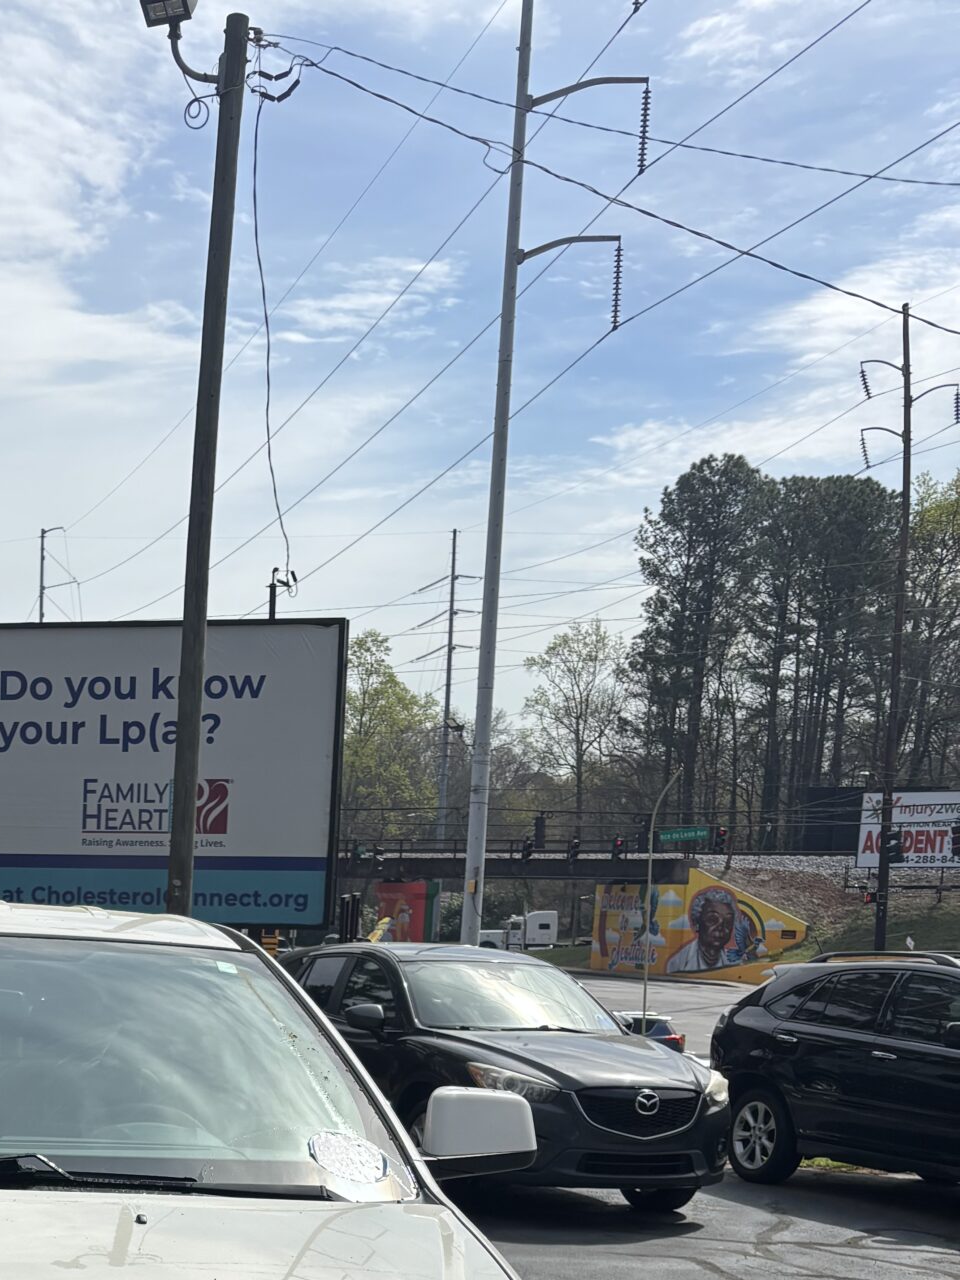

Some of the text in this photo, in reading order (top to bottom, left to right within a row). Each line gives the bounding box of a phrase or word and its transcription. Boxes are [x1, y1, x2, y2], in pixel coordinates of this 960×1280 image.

[0, 667, 267, 709] Do you kow
[99, 712, 222, 753] Lp(a?
[82, 778, 169, 803] FAMILY
[81, 803, 168, 830] HEART
[81, 838, 114, 849] Raising
[115, 838, 167, 848] Awareness.
[200, 839, 226, 848] Lives.
[861, 830, 949, 854] ACDENT
[2, 885, 24, 904] at
[30, 885, 309, 912] Cholesterolnnect.org
